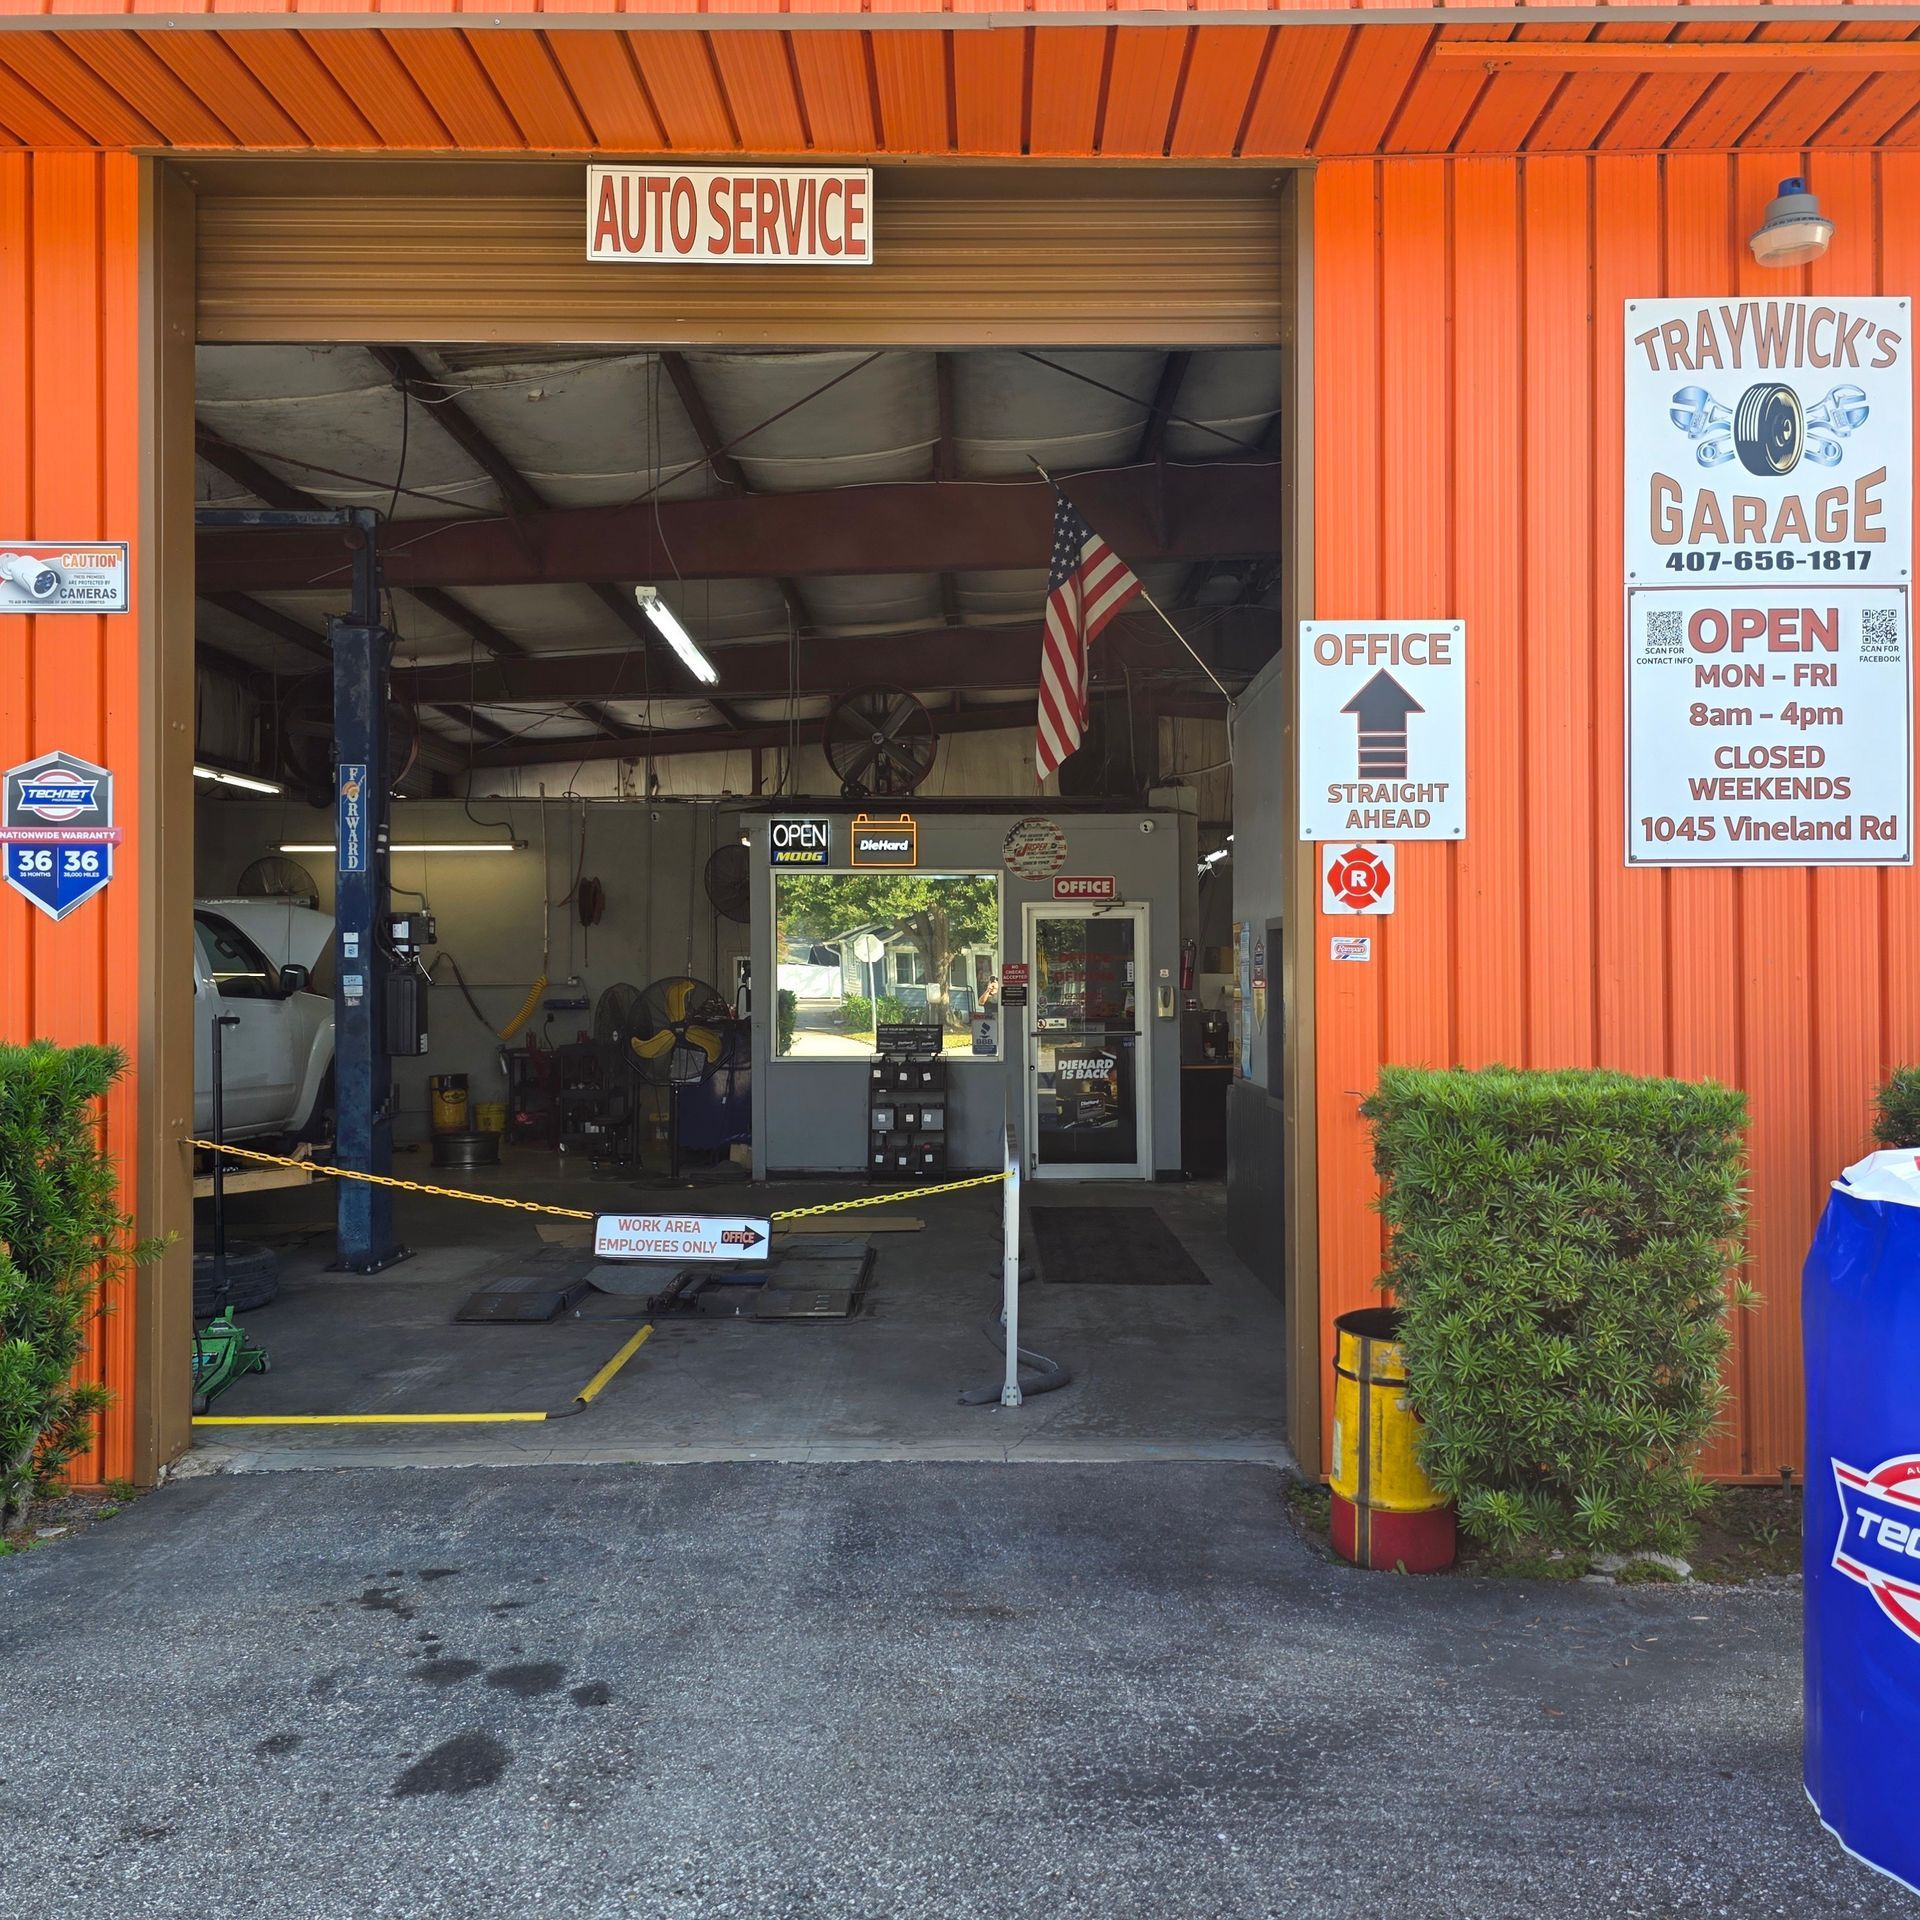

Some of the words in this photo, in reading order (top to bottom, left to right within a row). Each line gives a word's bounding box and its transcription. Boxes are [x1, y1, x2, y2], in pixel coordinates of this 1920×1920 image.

[594, 175, 697, 254] AUTO
[708, 176, 866, 256] SERVICE
[1634, 302, 1902, 371] TRAYWICK'S
[1650, 466, 1886, 545] GARAGE
[62, 555, 117, 568] CAUTION
[1666, 550, 1872, 572] 407-656-1817
[60, 588, 117, 599] CAMERAS
[1687, 608, 1839, 654] OPEN
[1314, 633, 1451, 666] OFFICE
[1695, 664, 1764, 688] MON
[1794, 663, 1837, 687] FRI
[1689, 703, 1752, 726] 8am
[1780, 702, 1843, 730] 4pm
[1714, 746, 1826, 769] CLOSED
[28, 789, 90, 798] TECHNET
[1327, 783, 1449, 804] STRAIGHT
[1688, 776, 1851, 801] WEEKENDS
[345, 767, 360, 869] FORWARD
[1346, 809, 1431, 829] AHEAD
[1641, 816, 1716, 842] 1045
[1724, 815, 1852, 841] Vineland
[1860, 815, 1897, 841] Rd
[0, 831, 59, 839] NATIONWIDE
[61, 831, 116, 839] WARRANTY
[773, 824, 826, 847] OPEN
[860, 840, 909, 851] DieHard
[18, 850, 52, 871] 36
[64, 850, 99, 871] 36
[775, 852, 824, 862] MOOG
[1057, 881, 1110, 893] OFFICE
[1351, 870, 1367, 887] R
[1058, 1059, 1114, 1070] DIEHARD
[1062, 1070, 1074, 1079] IS
[1075, 1069, 1109, 1079] BACK
[618, 1219, 661, 1232] WORK
[664, 1220, 701, 1233] AREA
[598, 1238, 679, 1252] EMPLOYEES
[682, 1241, 717, 1253] ONLY
[722, 1231, 754, 1243] OFFICE
